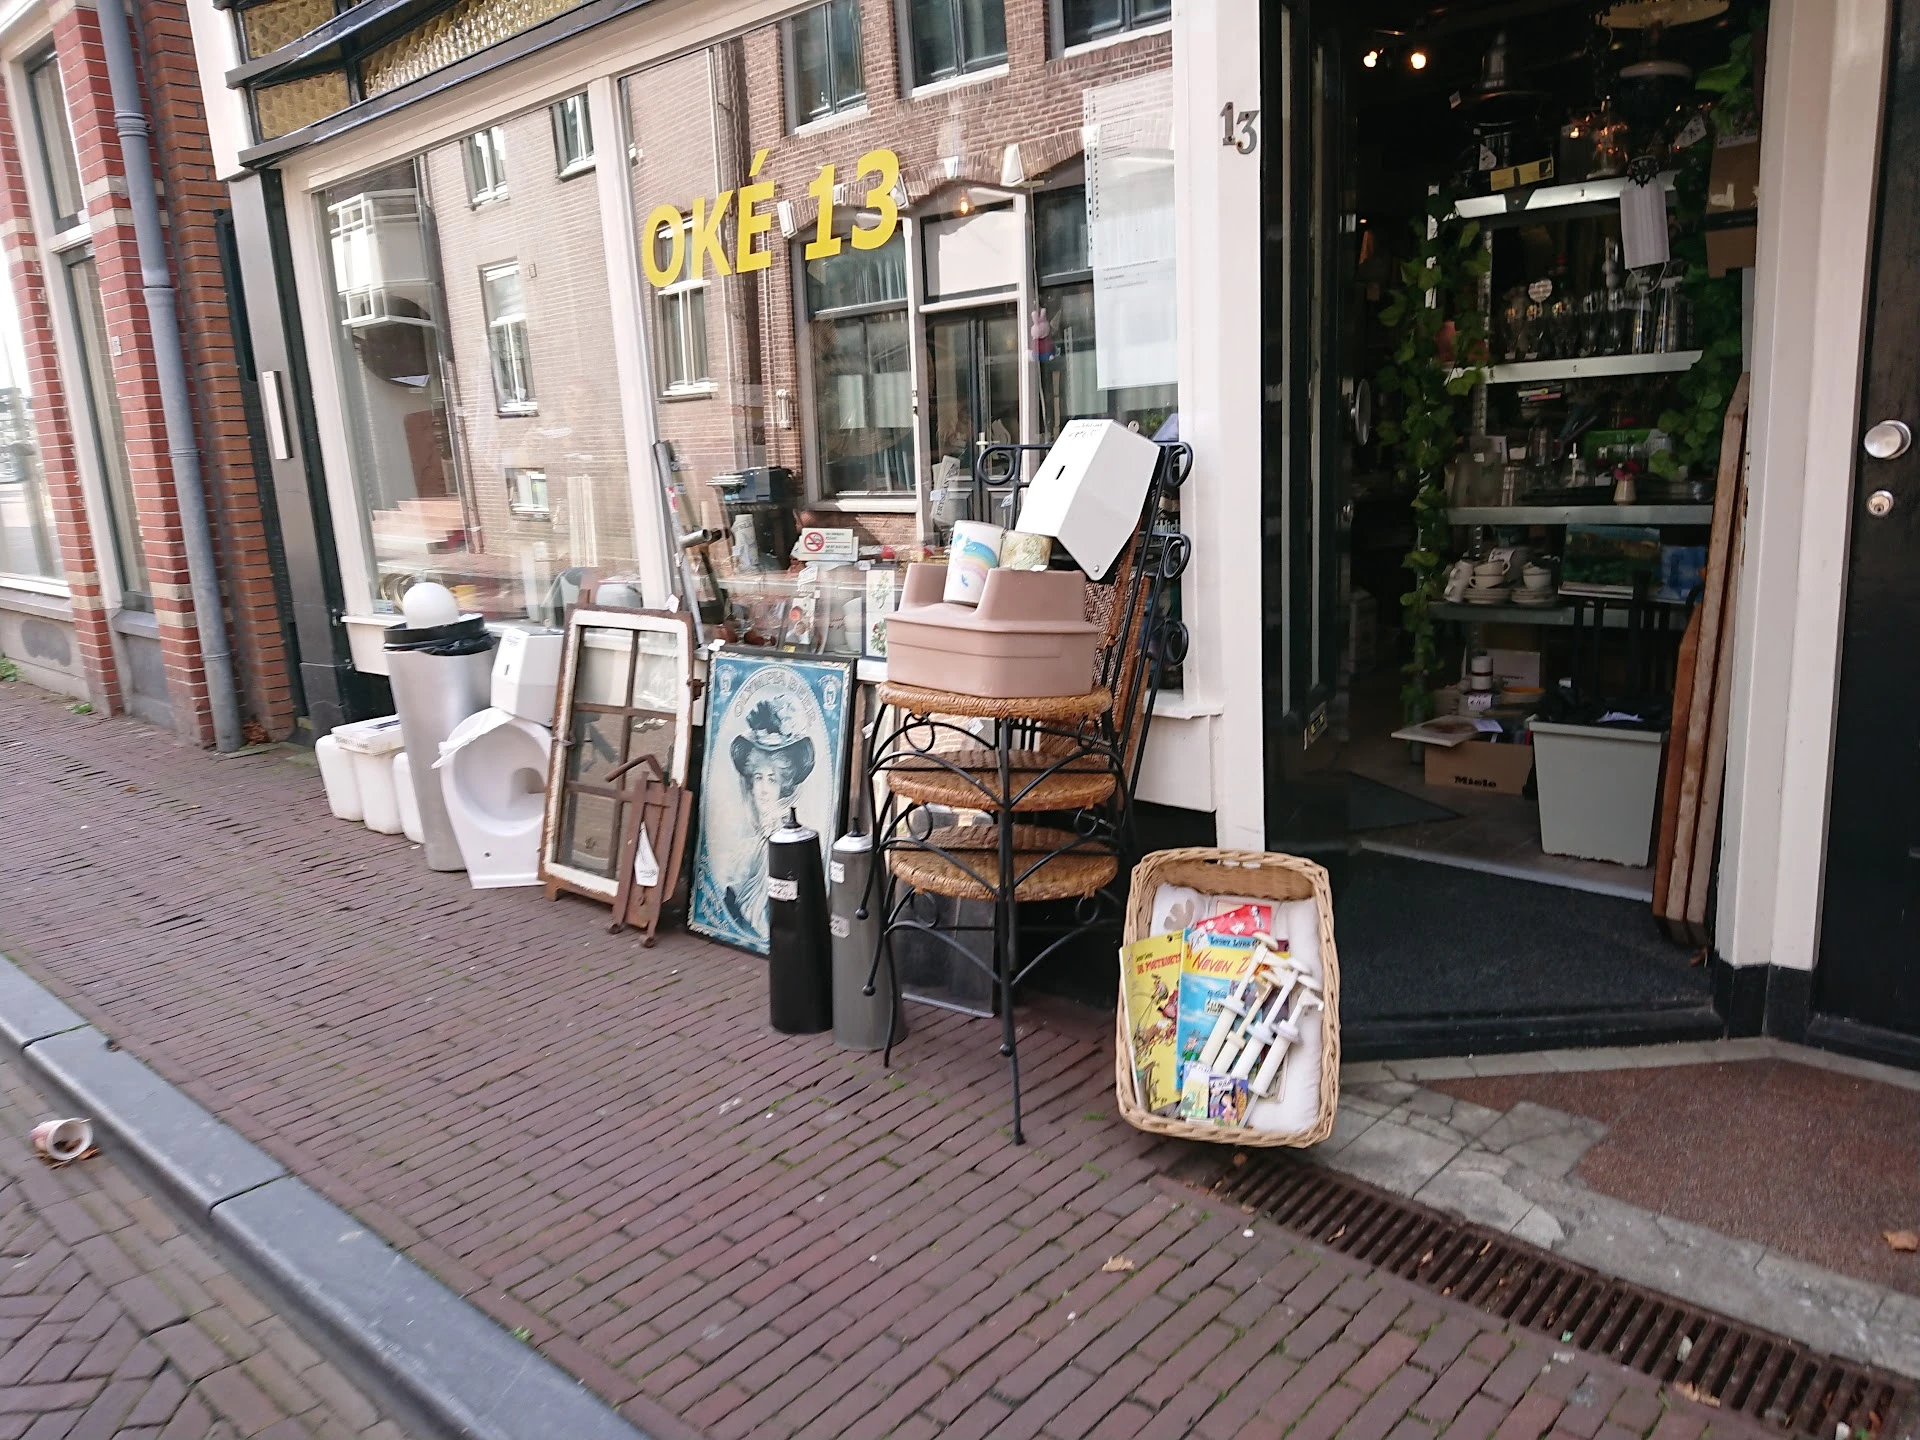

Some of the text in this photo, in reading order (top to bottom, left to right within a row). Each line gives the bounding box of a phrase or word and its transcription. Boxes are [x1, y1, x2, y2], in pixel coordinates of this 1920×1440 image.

[1220, 101, 1260, 155] 13
[641, 148, 900, 288] OKÉ 13
[1454, 775, 1497, 789] Miele
